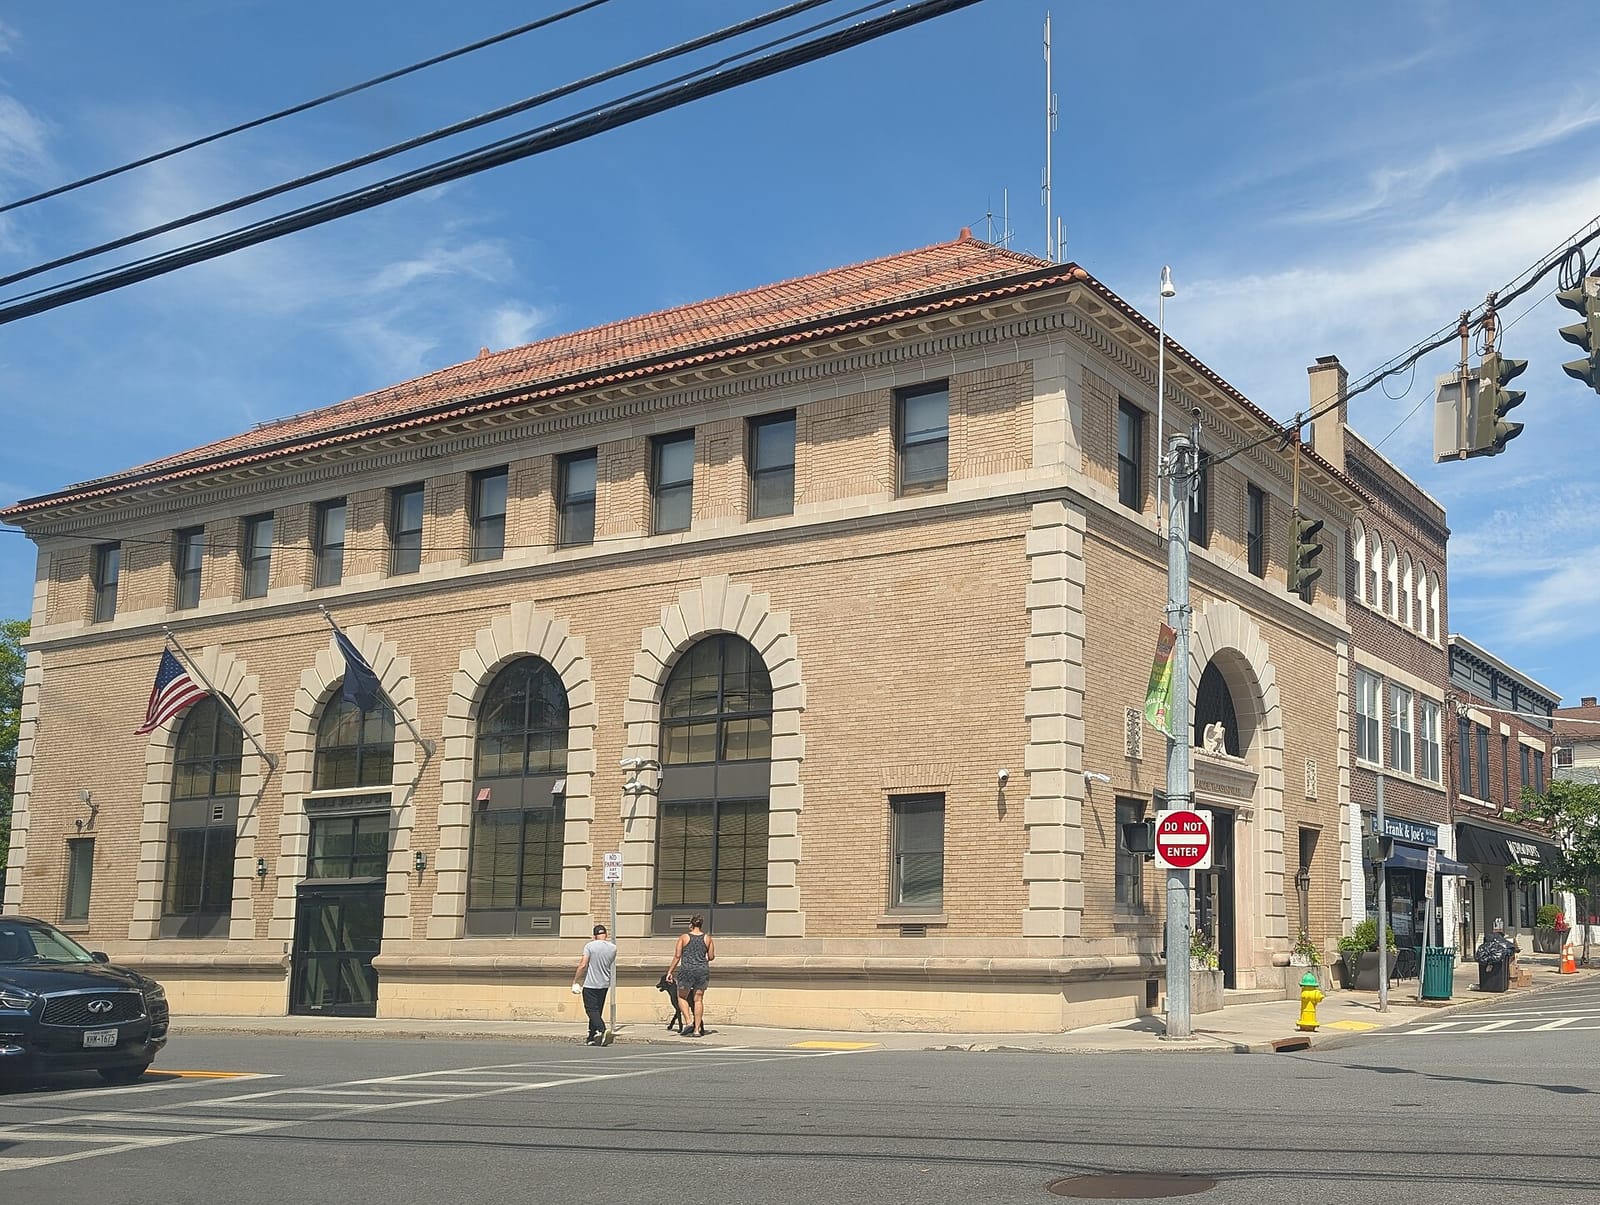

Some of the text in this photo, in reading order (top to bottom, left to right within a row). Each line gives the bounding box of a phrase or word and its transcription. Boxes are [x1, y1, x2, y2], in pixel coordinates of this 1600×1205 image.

[1164, 822, 1203, 832] DO NOT
[1385, 819, 1404, 837] Frank
[1404, 824, 1410, 838] &
[1410, 825, 1424, 842] Joe's
[1167, 847, 1198, 857] ENTER
